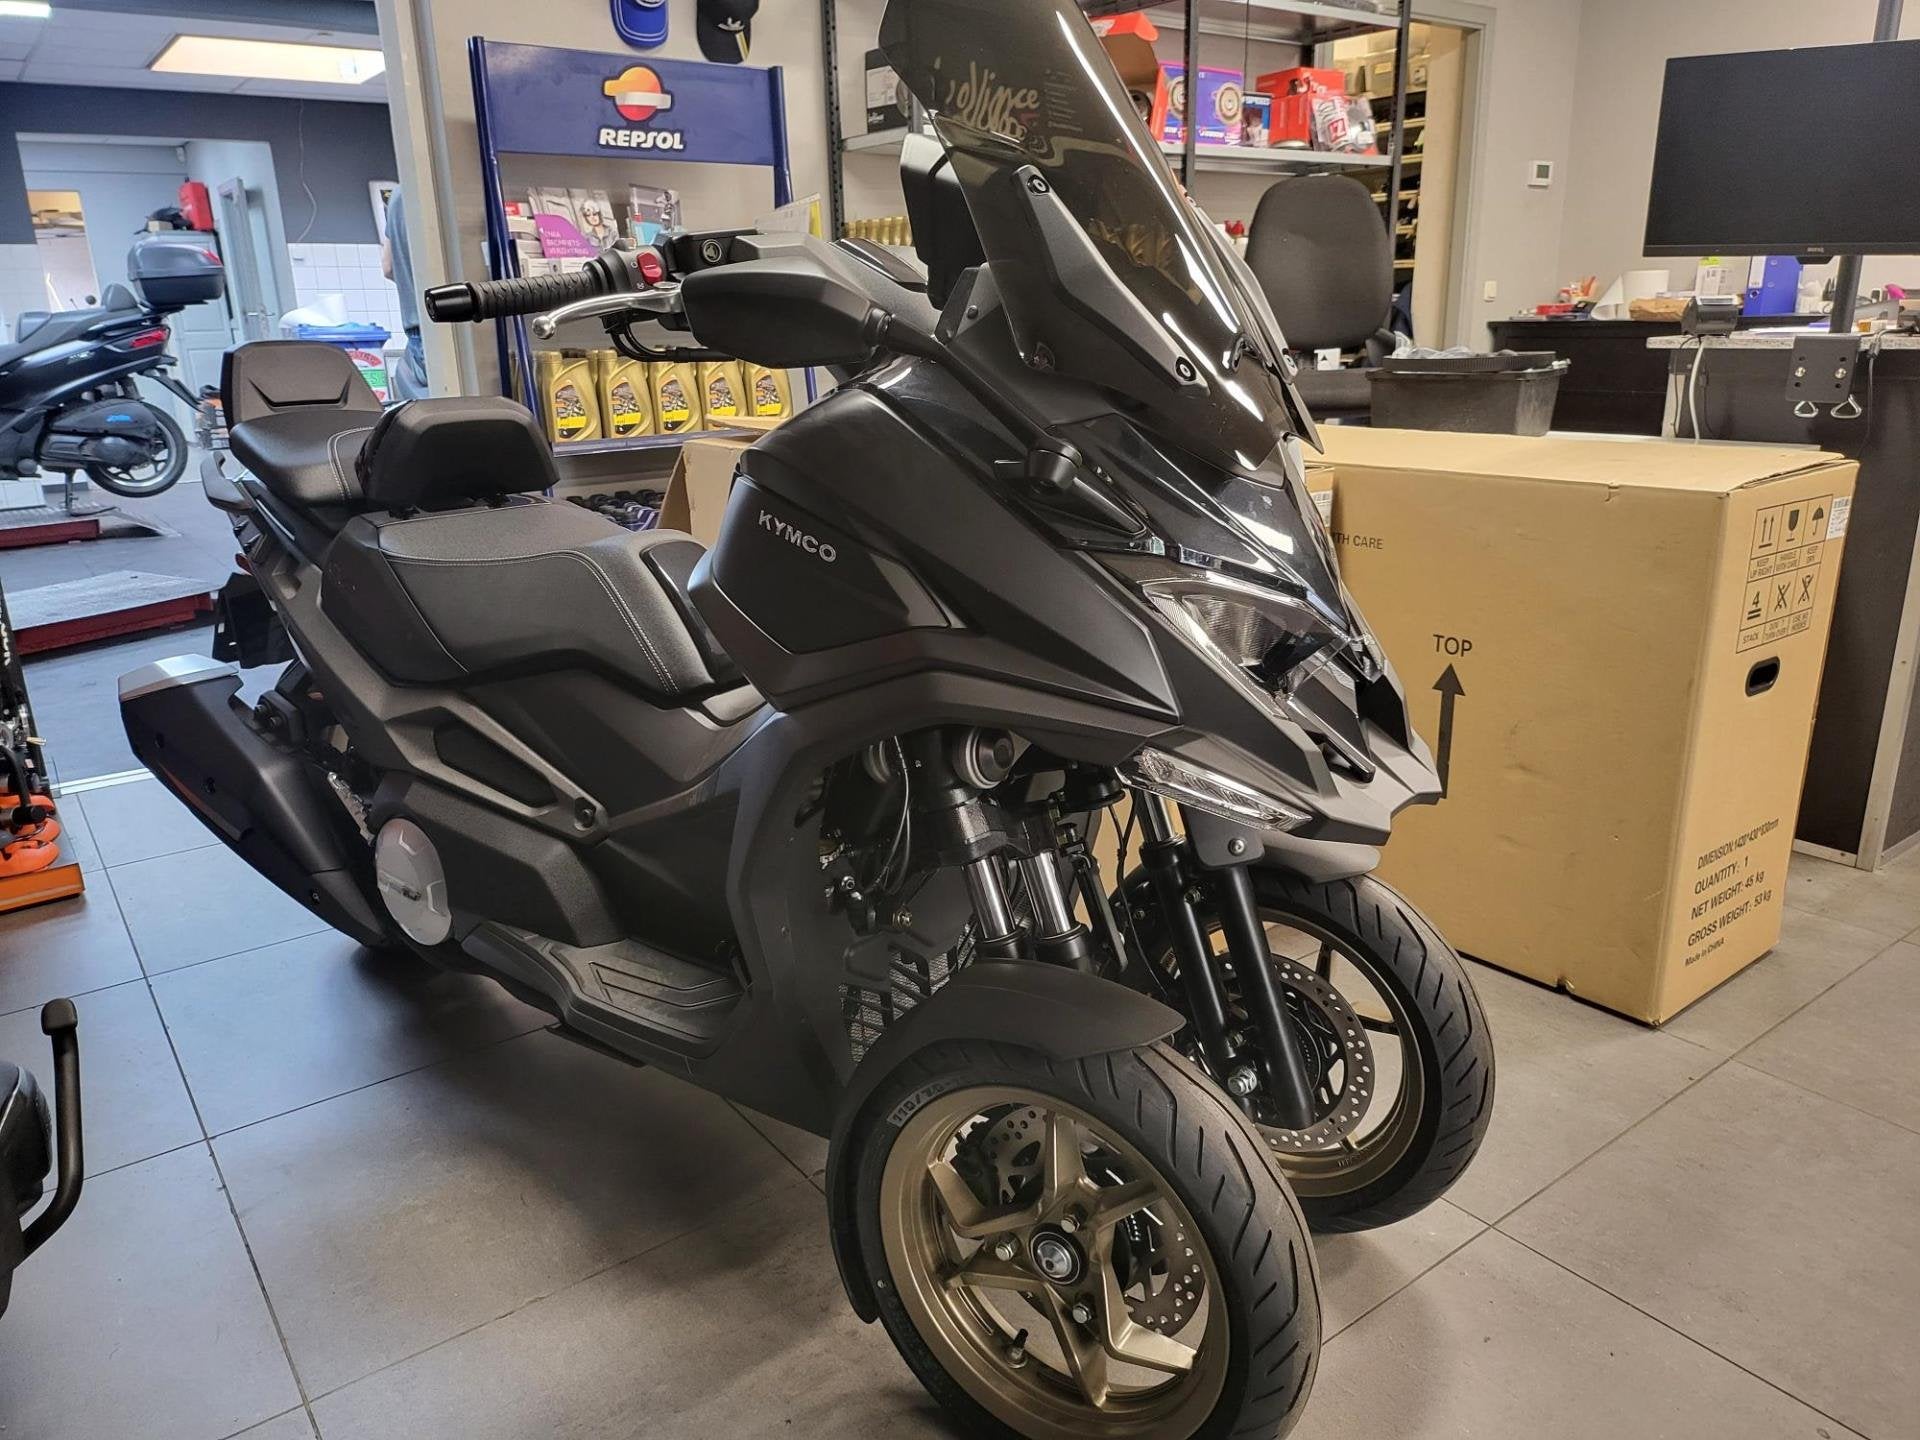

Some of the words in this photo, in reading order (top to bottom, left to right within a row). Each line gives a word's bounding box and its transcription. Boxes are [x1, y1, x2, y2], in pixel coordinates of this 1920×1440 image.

[599, 128, 684, 149] REPSOL
[759, 510, 837, 562] KYMCO
[1353, 535, 1384, 549] CARE
[1752, 591, 1760, 607] 4
[1433, 634, 1472, 657] TOP
[1743, 632, 1759, 643] STACK
[1695, 862, 1739, 894] QUANTITY:
[1744, 855, 1749, 867] 1
[1691, 899, 1710, 920] NET
[1711, 881, 1744, 910] WEIGHT:
[1745, 874, 1755, 888] 45
[1756, 871, 1765, 884] kg
[1688, 919, 1718, 947] GROSS
[1719, 901, 1752, 929] WEIGHT:
[1754, 892, 1763, 907] 53
[1763, 889, 1773, 902] kg
